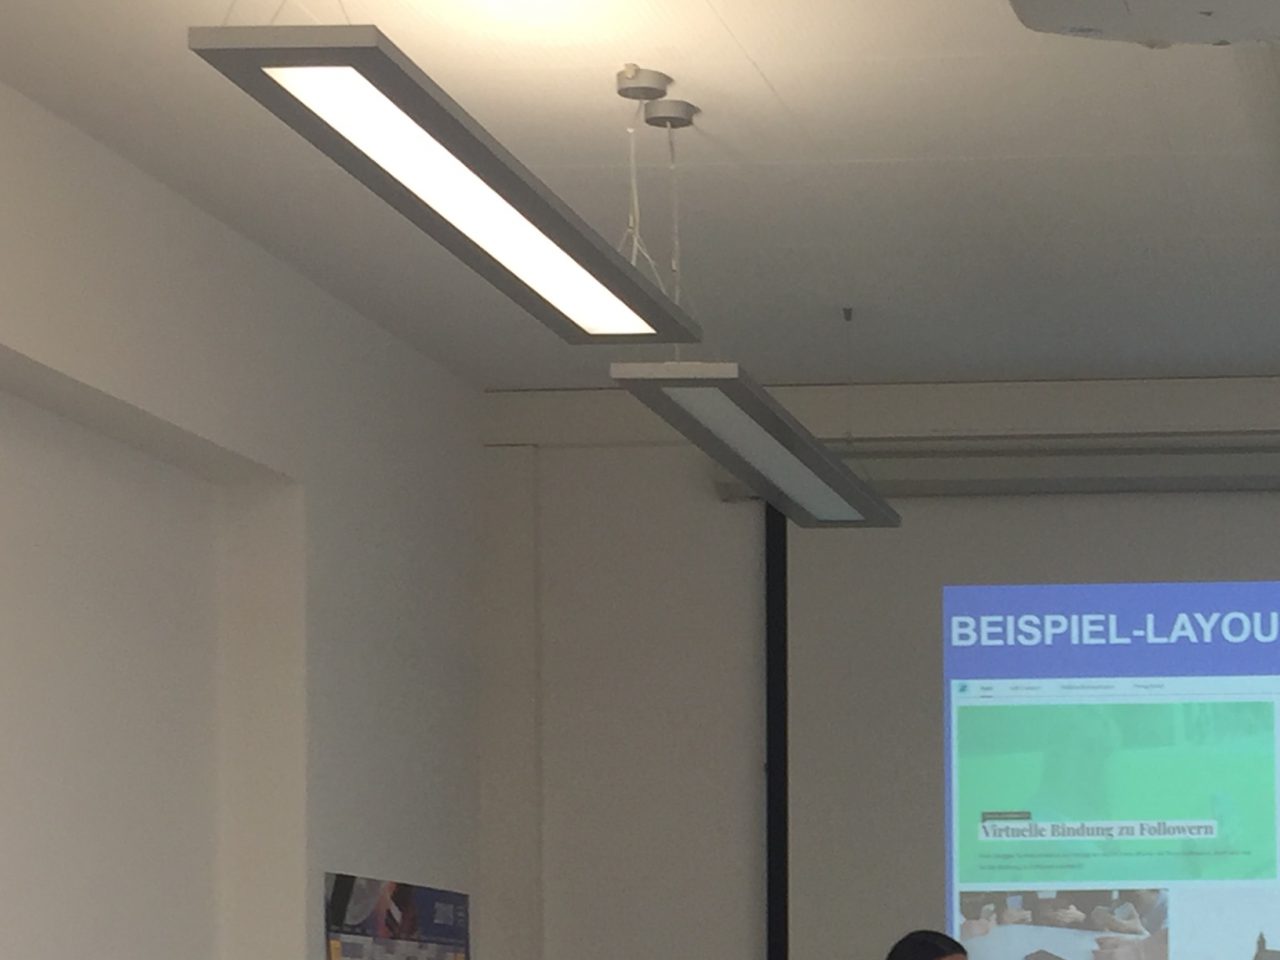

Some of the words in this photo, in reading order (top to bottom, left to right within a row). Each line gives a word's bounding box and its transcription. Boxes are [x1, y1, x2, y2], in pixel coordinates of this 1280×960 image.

[982, 822, 1047, 838] Virtuelle
[1050, 821, 1114, 839] Bindung
[1117, 825, 1135, 837] zu
[1138, 821, 1215, 837] Followern
